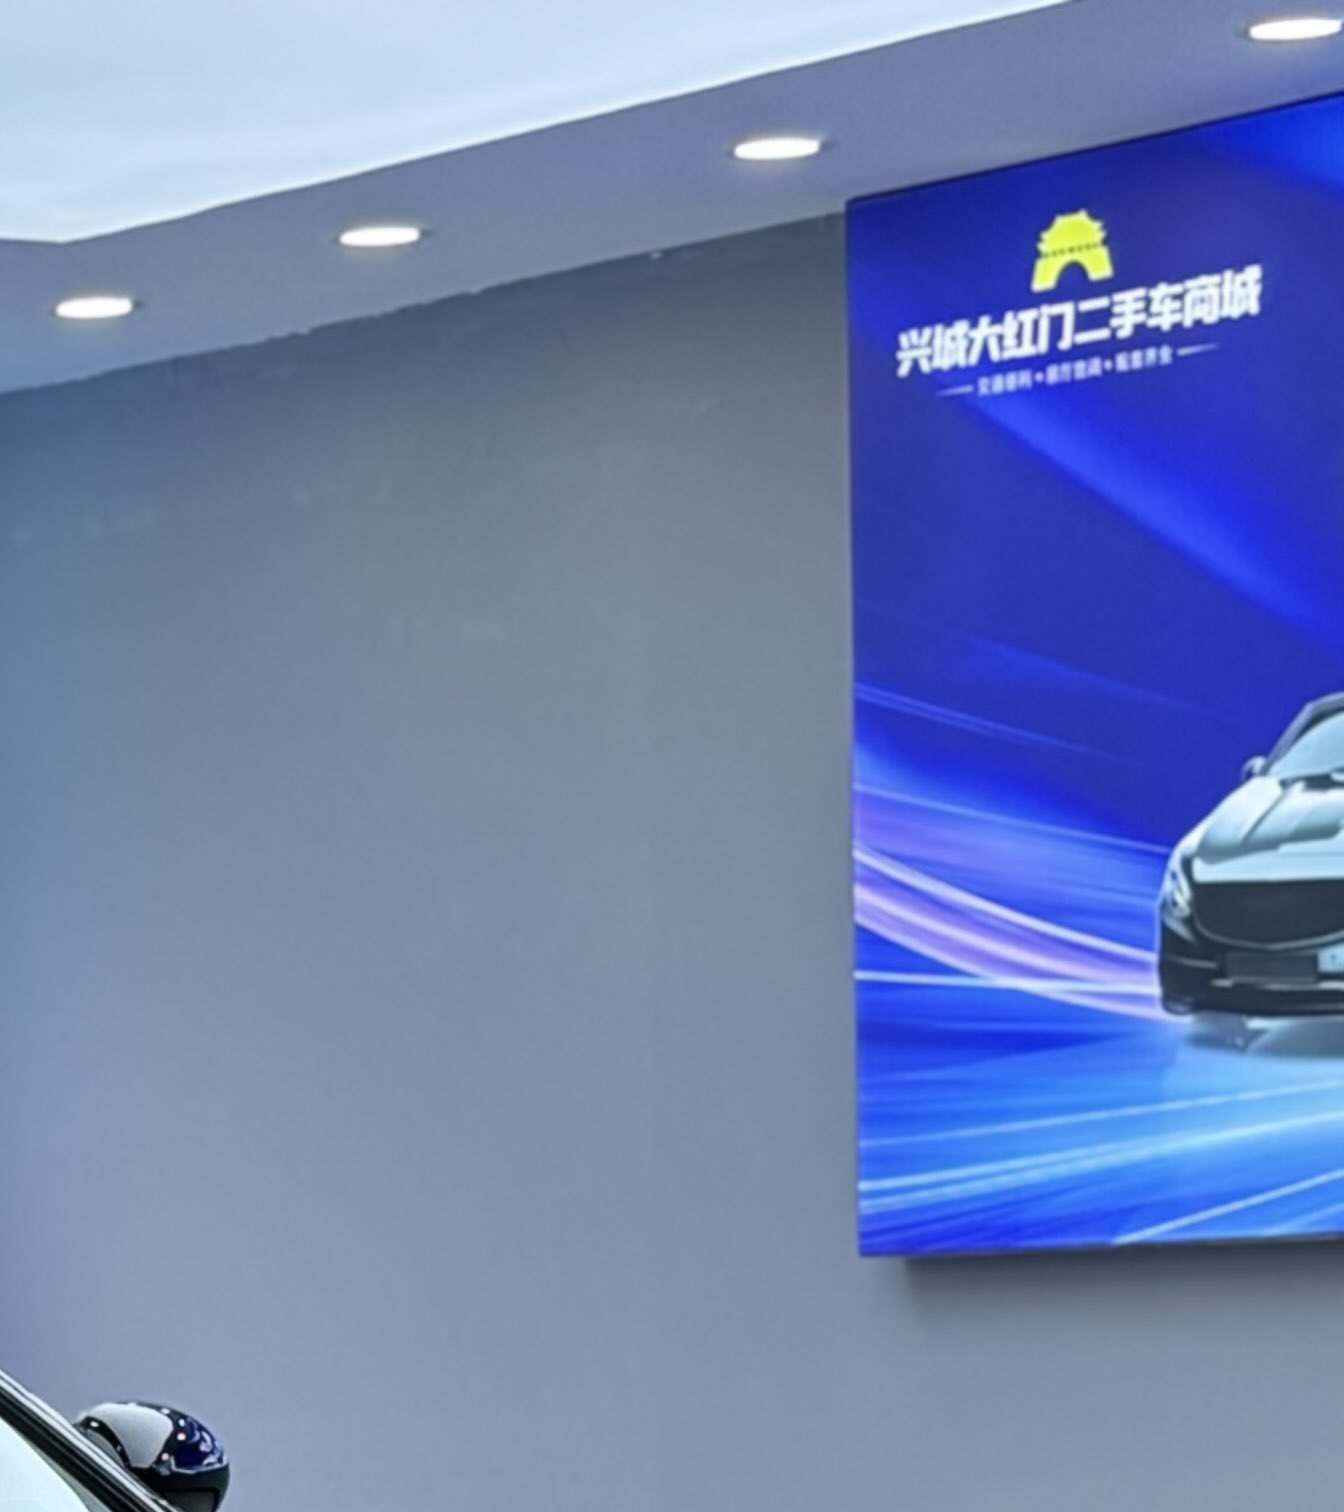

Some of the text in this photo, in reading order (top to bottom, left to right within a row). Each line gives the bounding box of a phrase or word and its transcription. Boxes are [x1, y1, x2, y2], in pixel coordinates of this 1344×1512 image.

[896, 264, 1264, 378] 兴城大红门二手车商城
